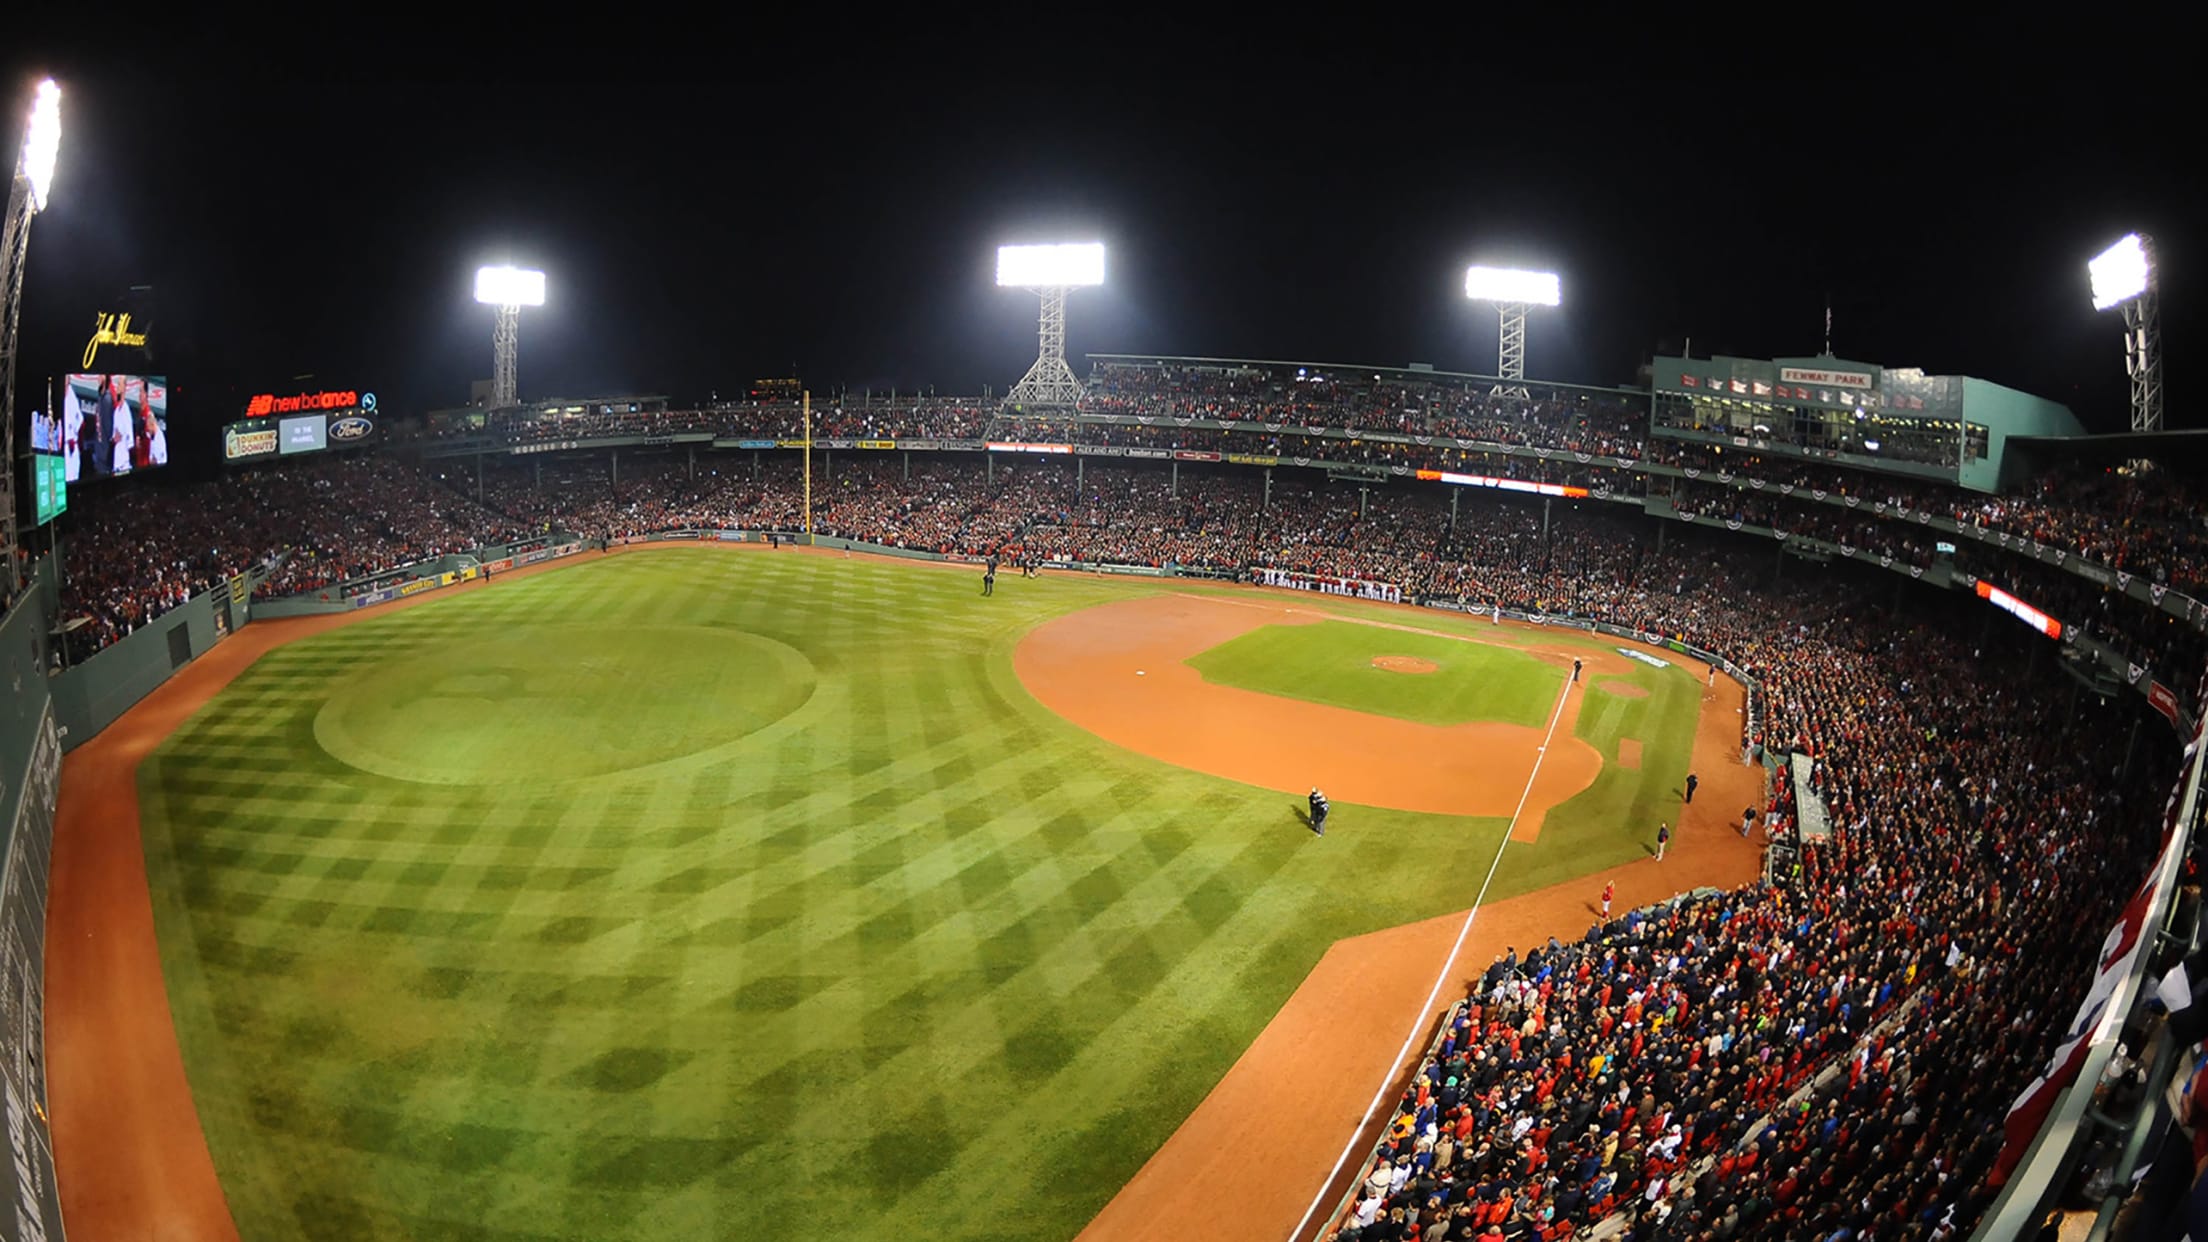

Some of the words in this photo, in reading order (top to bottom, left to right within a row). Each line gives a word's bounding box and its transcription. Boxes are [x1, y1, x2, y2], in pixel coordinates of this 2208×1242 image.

[82, 311, 115, 369] John
[1785, 371, 1829, 381] FENWAY
[1834, 374, 1865, 385] PARK
[273, 396, 300, 412] new
[301, 391, 357, 410] balance
[336, 421, 365, 437] Ford
[241, 441, 275, 453] DONUTS
